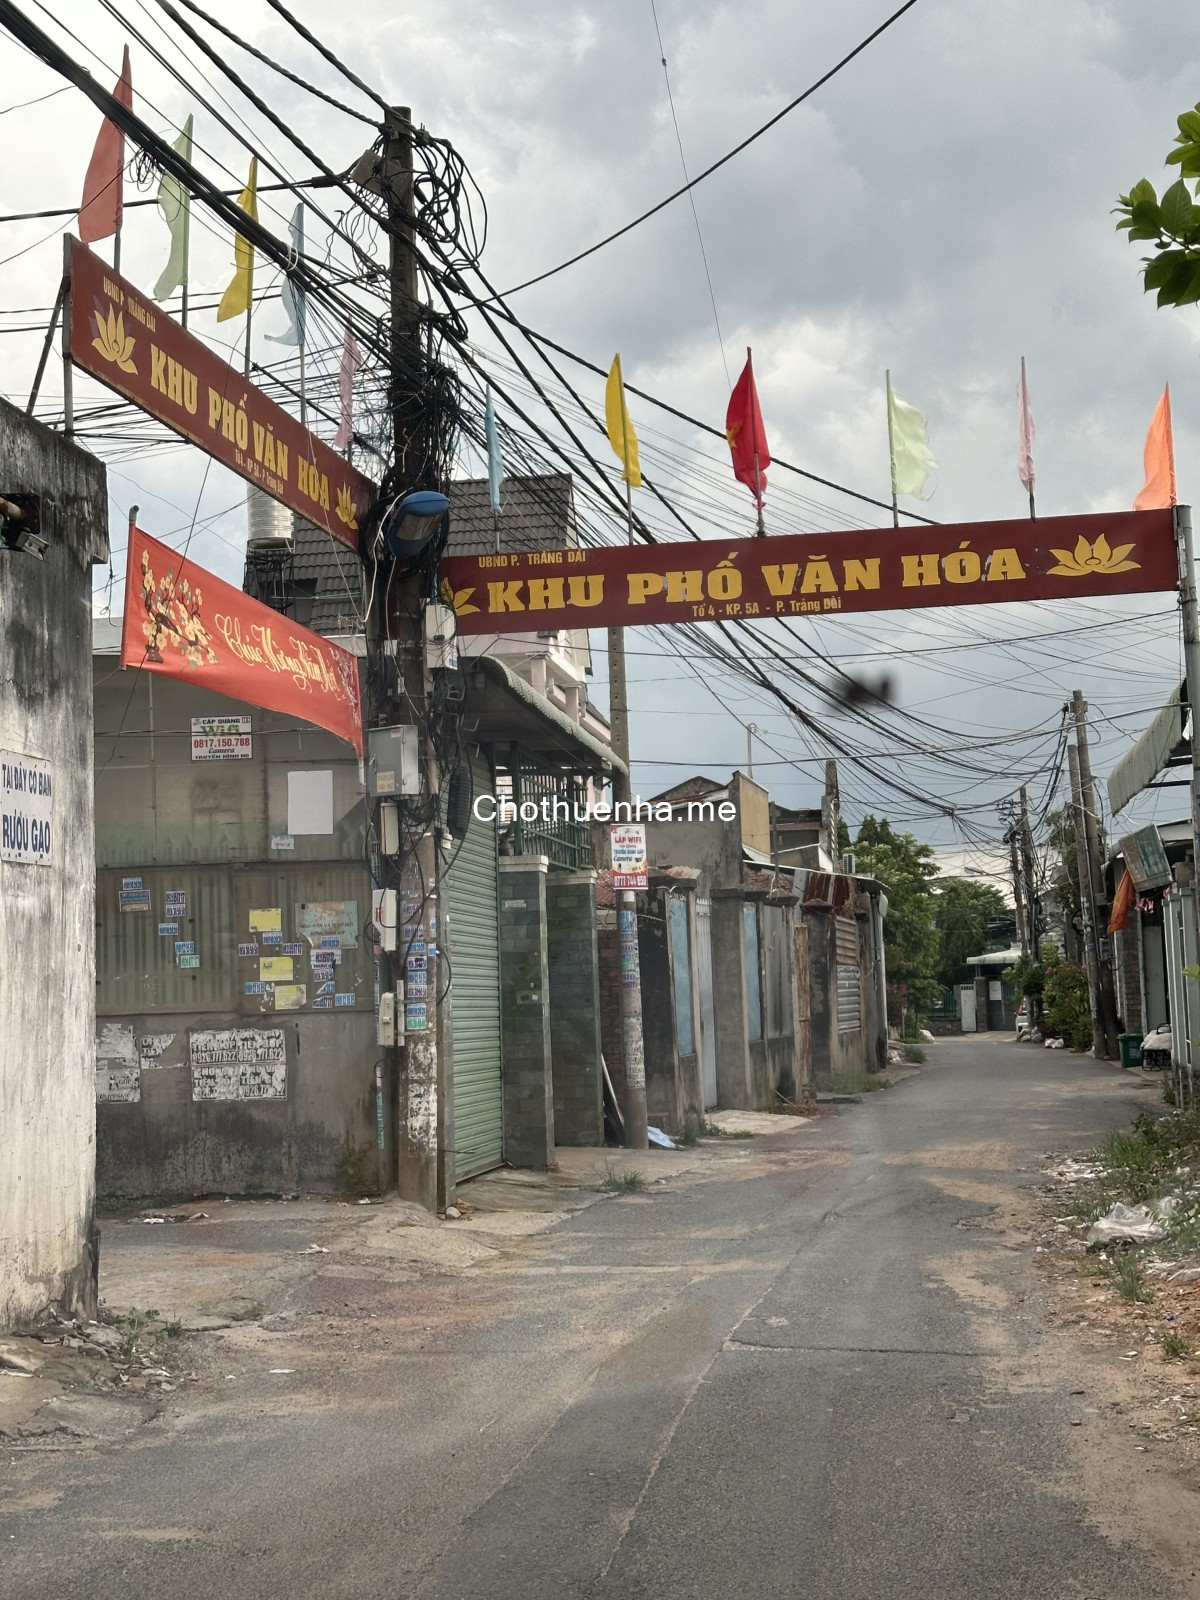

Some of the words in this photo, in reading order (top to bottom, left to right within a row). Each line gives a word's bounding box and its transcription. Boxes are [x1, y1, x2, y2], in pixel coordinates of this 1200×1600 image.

[150, 343, 198, 415] KHU
[208, 386, 249, 451] PHỐ
[252, 420, 289, 481] VĂN
[297, 455, 330, 511] HÓA
[478, 555, 508, 568] UBND
[510, 554, 520, 567] P.
[487, 574, 605, 613] KHU
[627, 551, 743, 604] PHỐ
[761, 554, 881, 597] VĂN
[901, 540, 1027, 587] HÓA
[708, 606, 715, 616] 4
[726, 603, 742, 615] KP.
[745, 602, 760, 614] 5A
[776, 601, 785, 612] P.
[194, 738, 250, 748] 0817.150.788
[2, 764, 13, 795] TẠI
[28, 764, 37, 794] CÓ
[2, 809, 28, 857] RƯỢU
[31, 818, 51, 859] GẠO
[614, 875, 626, 887] 0777
